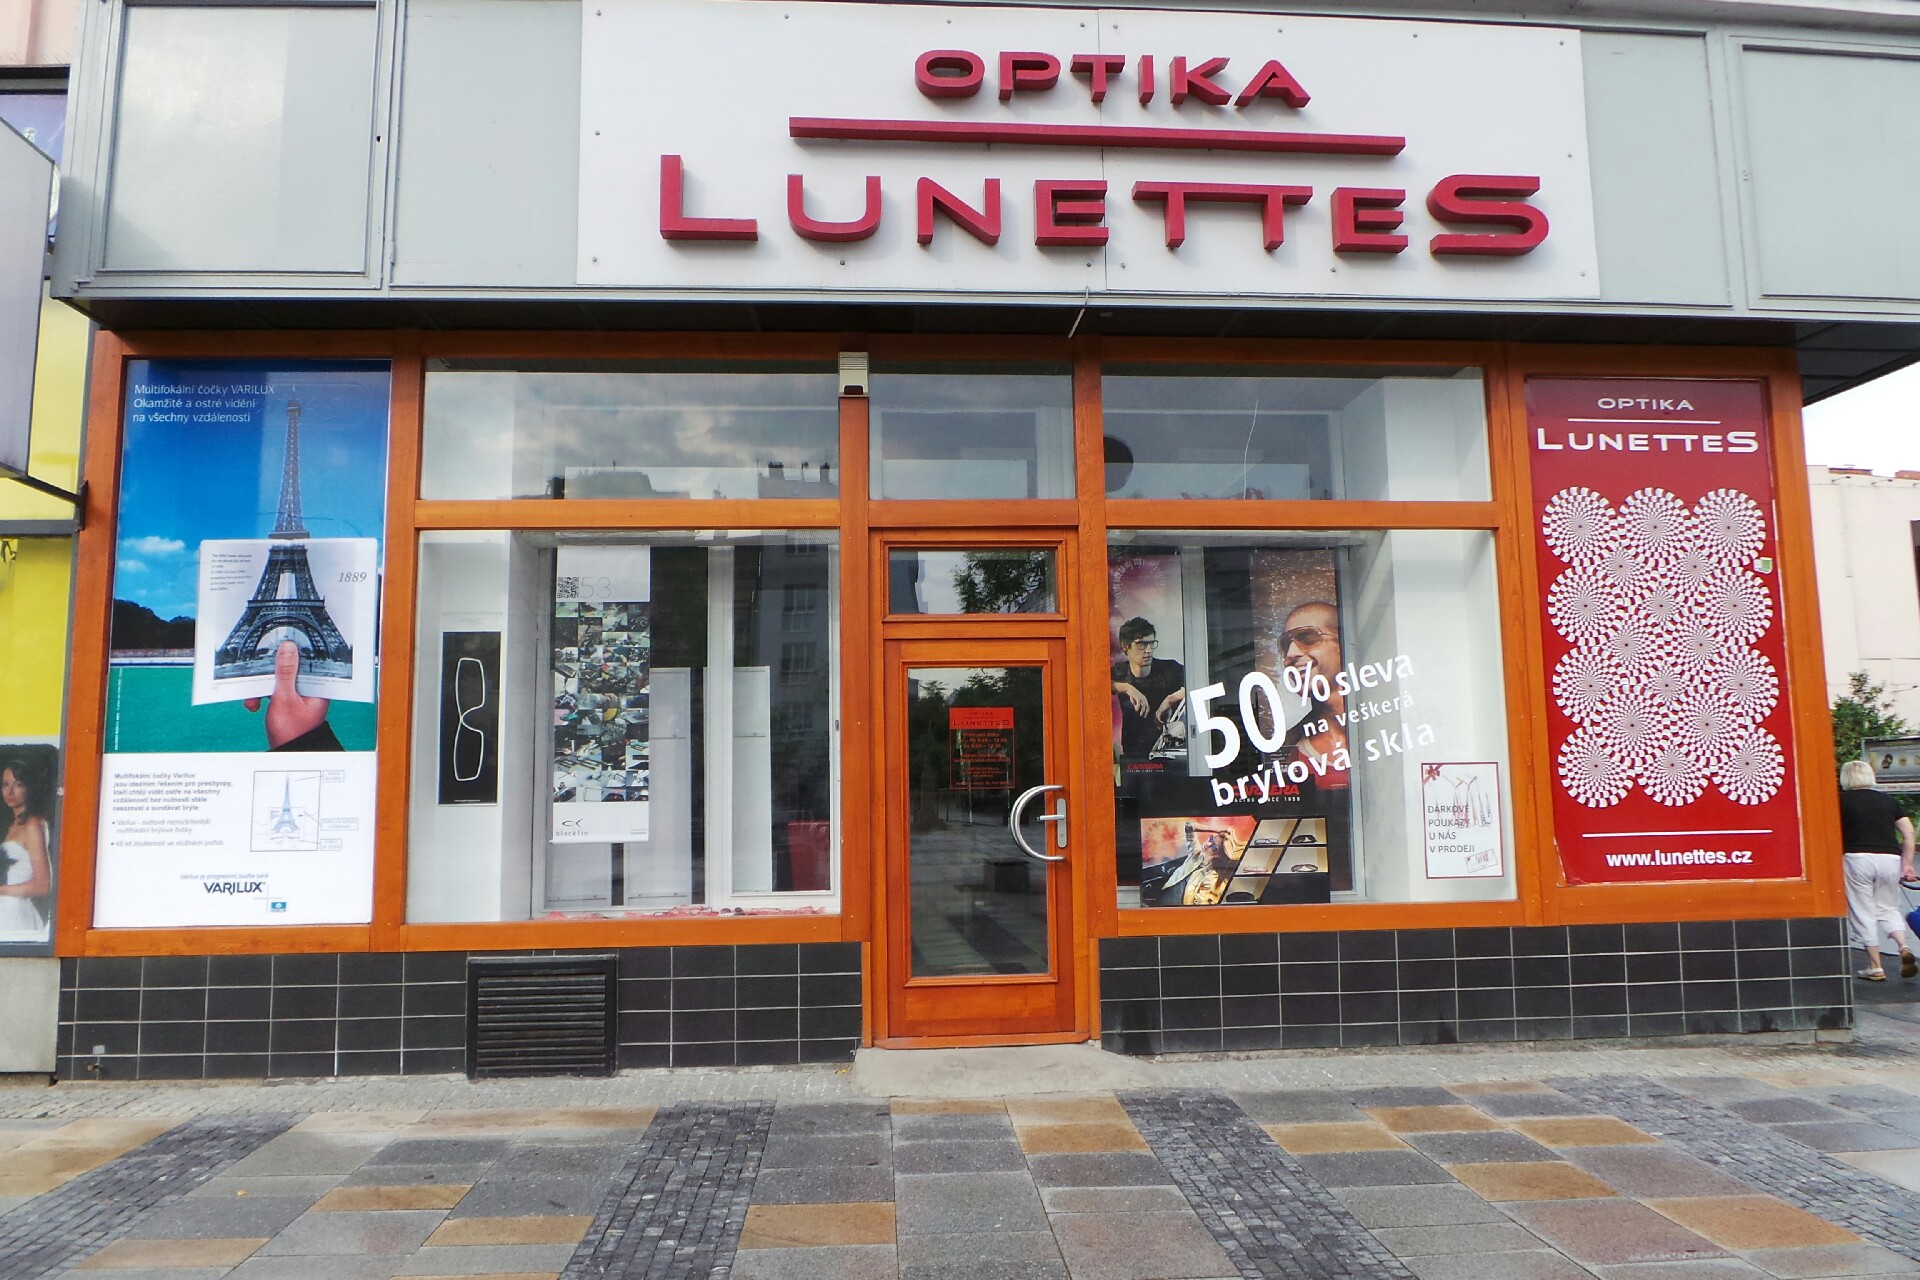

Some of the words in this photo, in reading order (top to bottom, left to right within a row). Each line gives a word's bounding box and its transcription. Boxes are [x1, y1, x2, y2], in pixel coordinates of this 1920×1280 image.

[915, 49, 1310, 109] OPTIKA
[660, 154, 1550, 256] LUNETTES
[134, 384, 195, 395] Multifokální
[197, 384, 228, 396] čočky
[231, 384, 275, 394] VARILUX
[133, 398, 182, 408] Okamžité
[186, 400, 192, 408] a
[195, 398, 222, 408] ostré
[225, 398, 256, 408] vidění
[1597, 397, 1694, 411] OPTIKA
[132, 414, 145, 422] na
[148, 412, 189, 424] všechny
[192, 412, 251, 423] vzdálenosti
[1537, 427, 1760, 453] LUNETTES
[338, 571, 368, 583] 1889
[580, 577, 611, 598] 53
[1335, 653, 1415, 697] sleva
[1302, 718, 1330, 737] na
[1335, 690, 1414, 727] veškerá
[1210, 740, 1352, 807] brýlová
[1364, 722, 1436, 762] skla
[1427, 803, 1469, 814] DÁRKOVÉ
[1429, 832, 1436, 840] U
[1438, 830, 1456, 840] NÁS
[1430, 845, 1436, 853] V
[1438, 845, 1475, 853] PRODEJI
[1605, 849, 1753, 867] www.lunettes.cz
[203, 881, 263, 896] VARILUX
